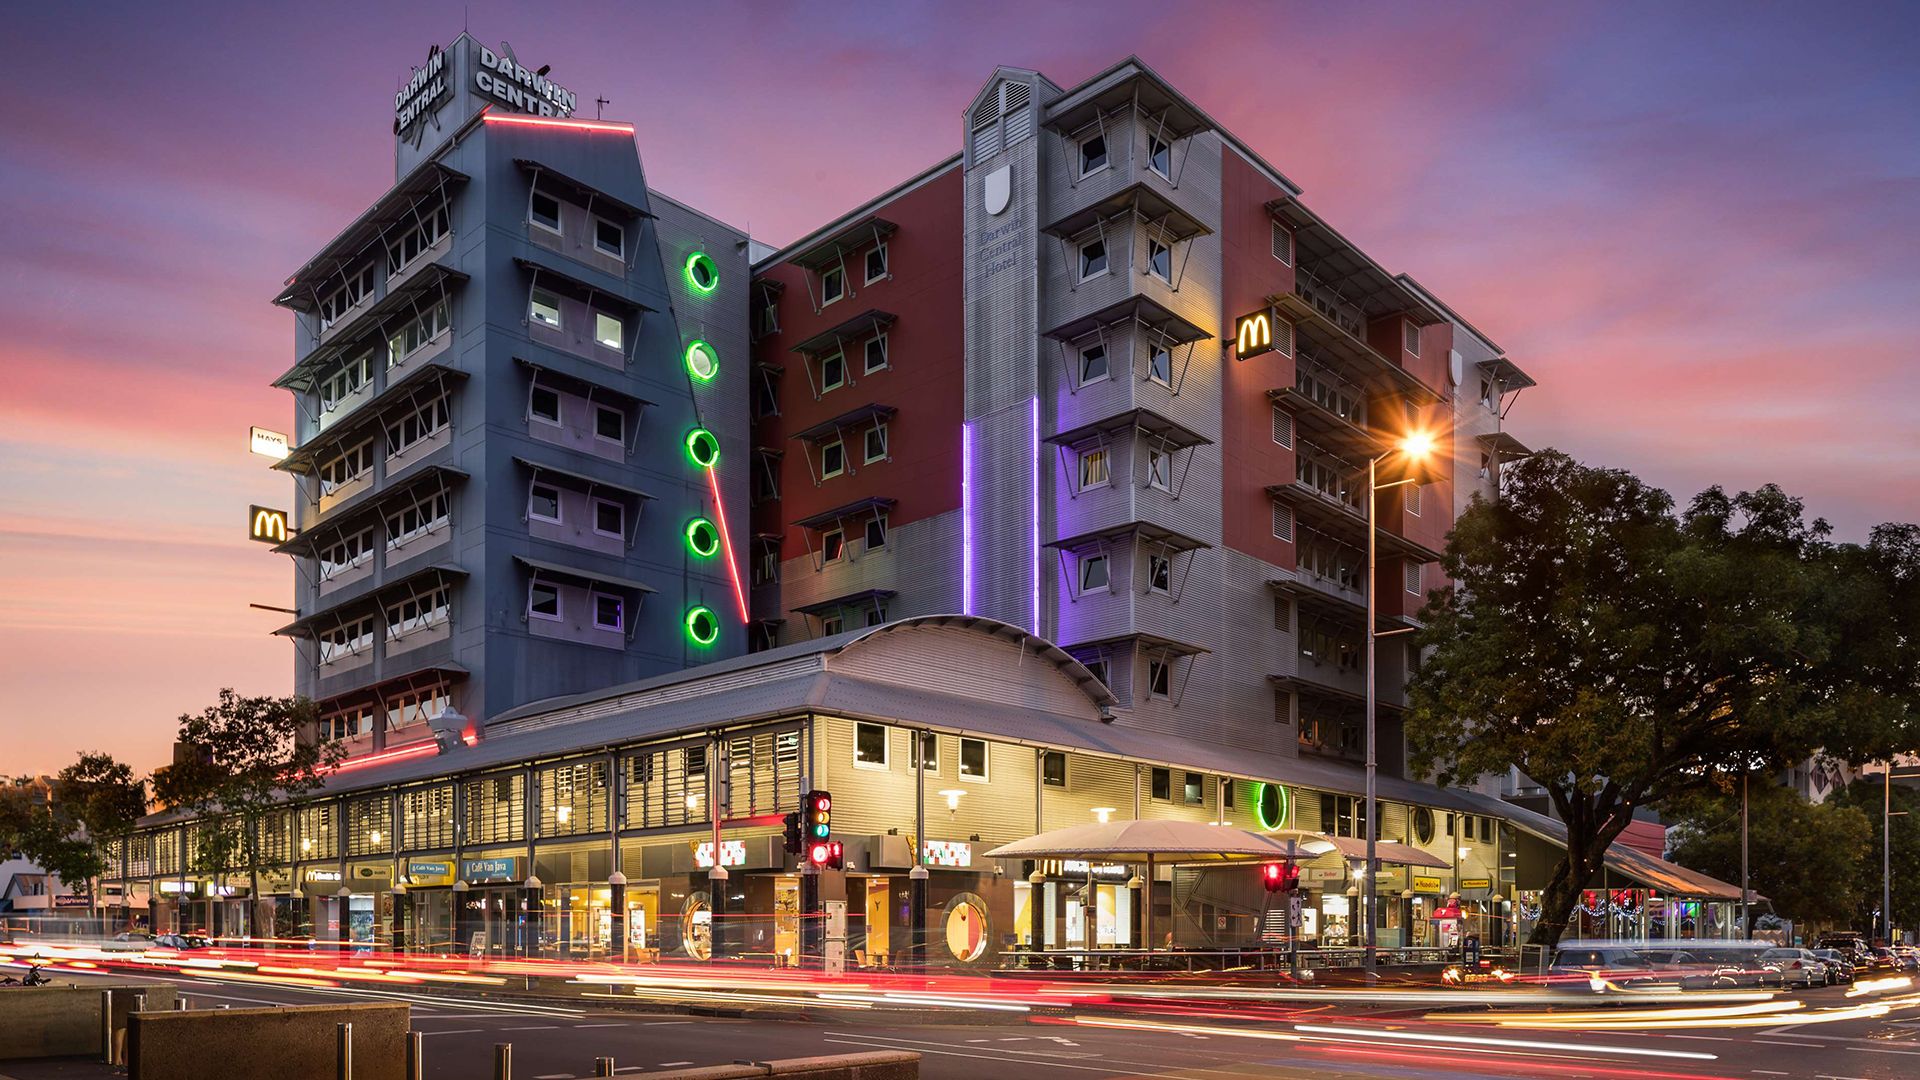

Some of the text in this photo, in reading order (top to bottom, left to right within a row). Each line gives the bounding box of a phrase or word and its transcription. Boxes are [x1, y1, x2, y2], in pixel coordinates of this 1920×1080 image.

[395, 52, 444, 111] DARWIN
[481, 47, 576, 110] DARWIN
[979, 231, 1022, 261] Central
[984, 252, 1016, 278] Hotel
[257, 433, 282, 444] HAYS
[484, 861, 494, 872] Van
[494, 860, 507, 874] Java
